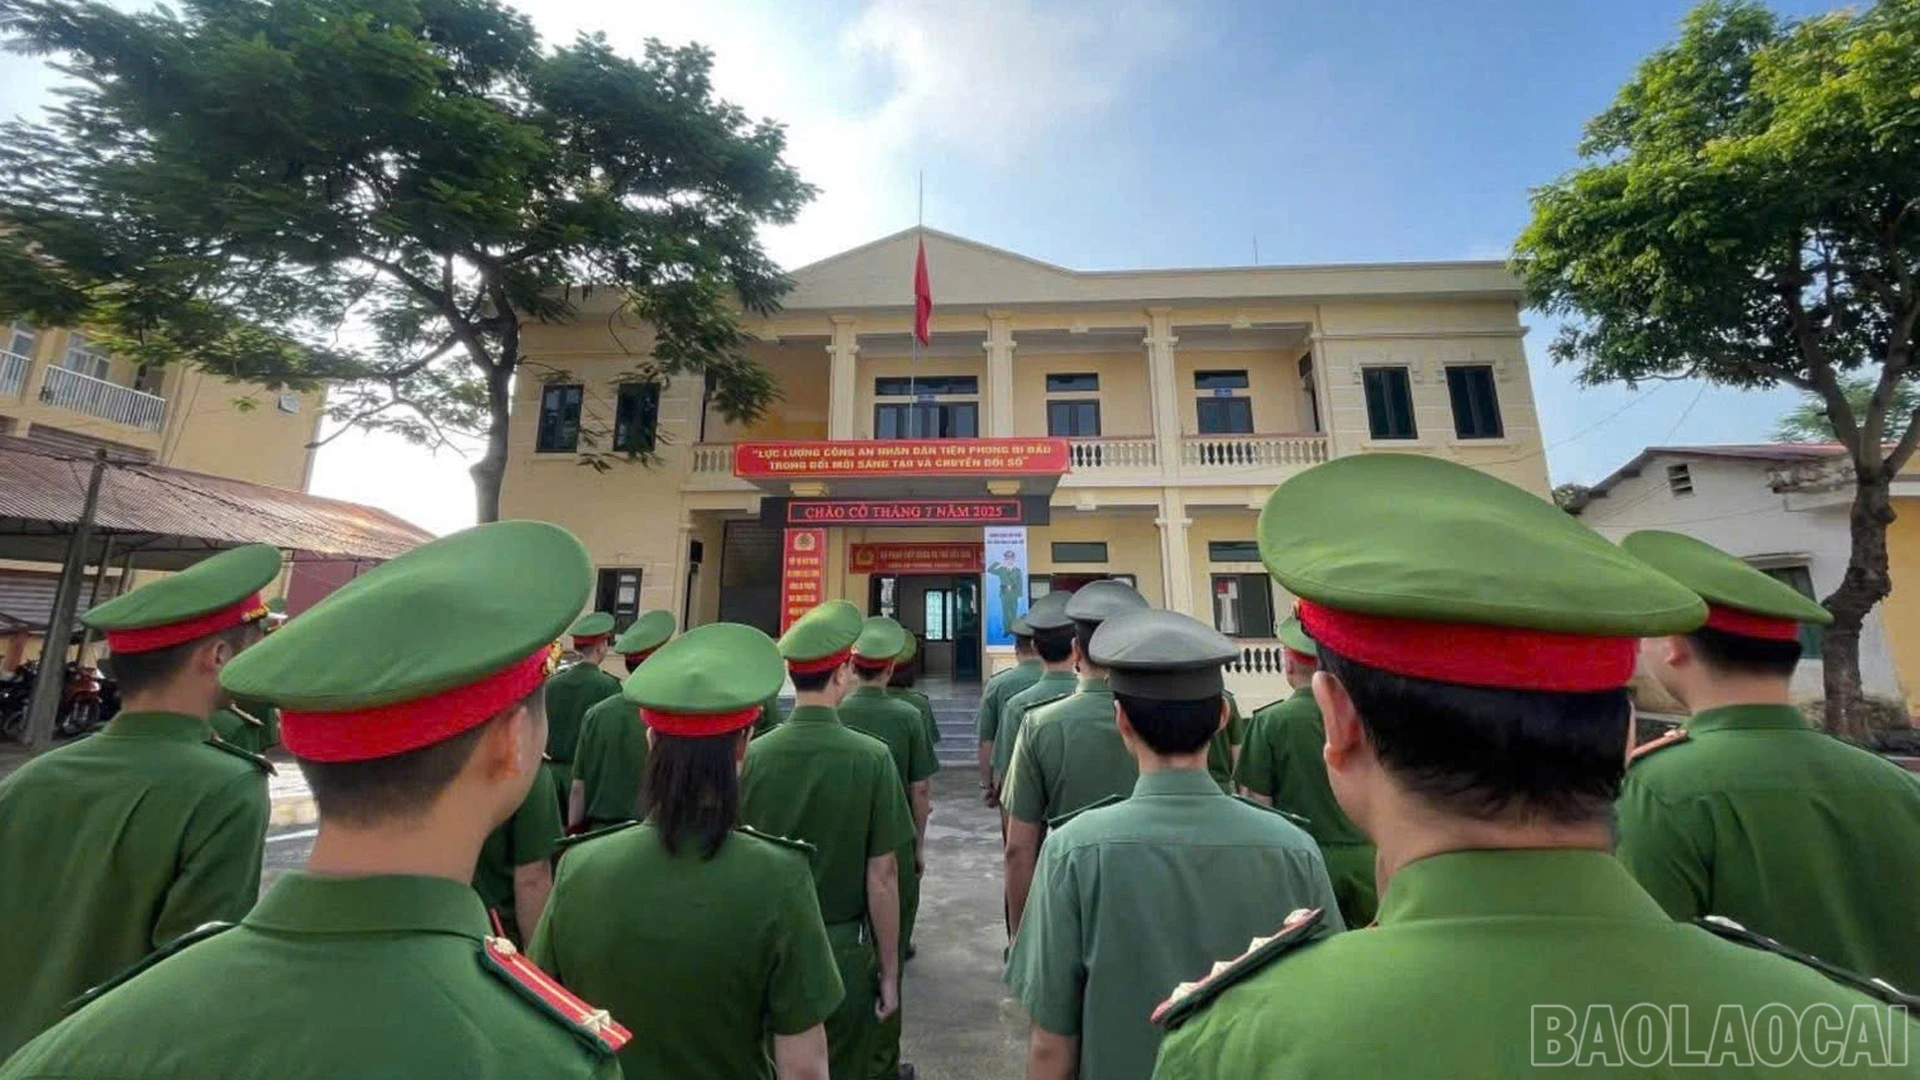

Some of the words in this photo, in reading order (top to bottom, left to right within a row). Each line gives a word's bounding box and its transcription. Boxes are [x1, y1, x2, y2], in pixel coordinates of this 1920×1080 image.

[823, 446, 855, 457] CÔNG
[858, 447, 874, 457] AN
[877, 445, 910, 456] NHÂN
[912, 445, 937, 455] DÂN
[968, 445, 1009, 454] PHONG
[769, 460, 807, 470] TRONG
[857, 459, 889, 469] SÁNG
[805, 504, 845, 518] CHÀO
[872, 504, 920, 518] THÁNG
[924, 506, 933, 517] 7
